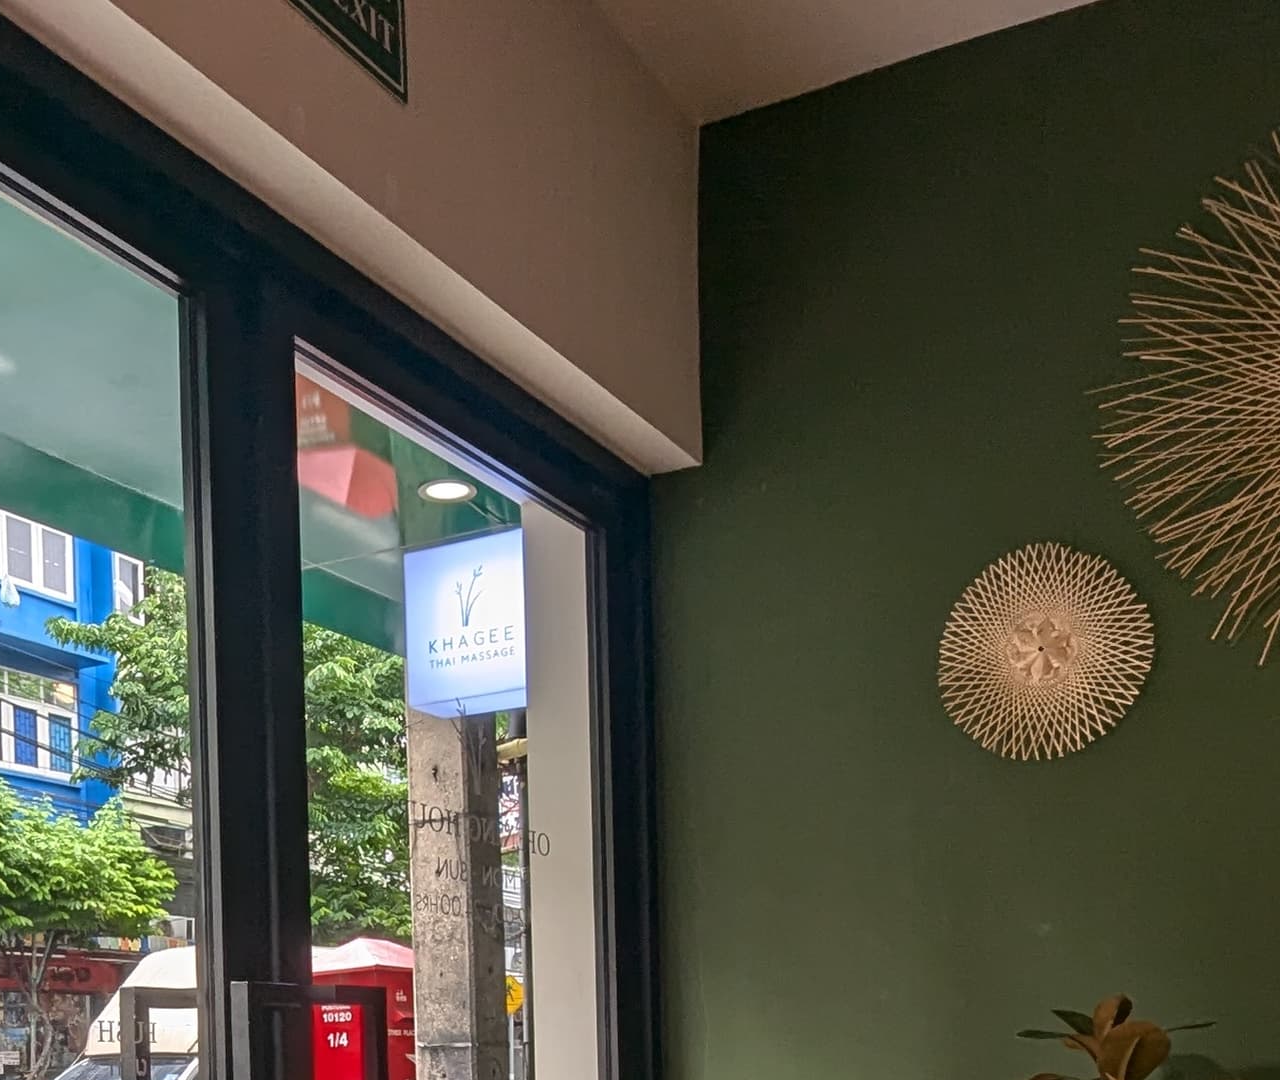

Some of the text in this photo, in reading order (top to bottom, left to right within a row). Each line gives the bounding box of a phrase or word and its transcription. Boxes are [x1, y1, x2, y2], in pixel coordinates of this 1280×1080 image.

[334, 0, 394, 54] XIT
[428, 624, 515, 655] KHAGEE
[429, 645, 516, 669] THAI MASSAGE
[322, 1012, 352, 1023] 10120
[327, 1032, 349, 1048] 1/4
